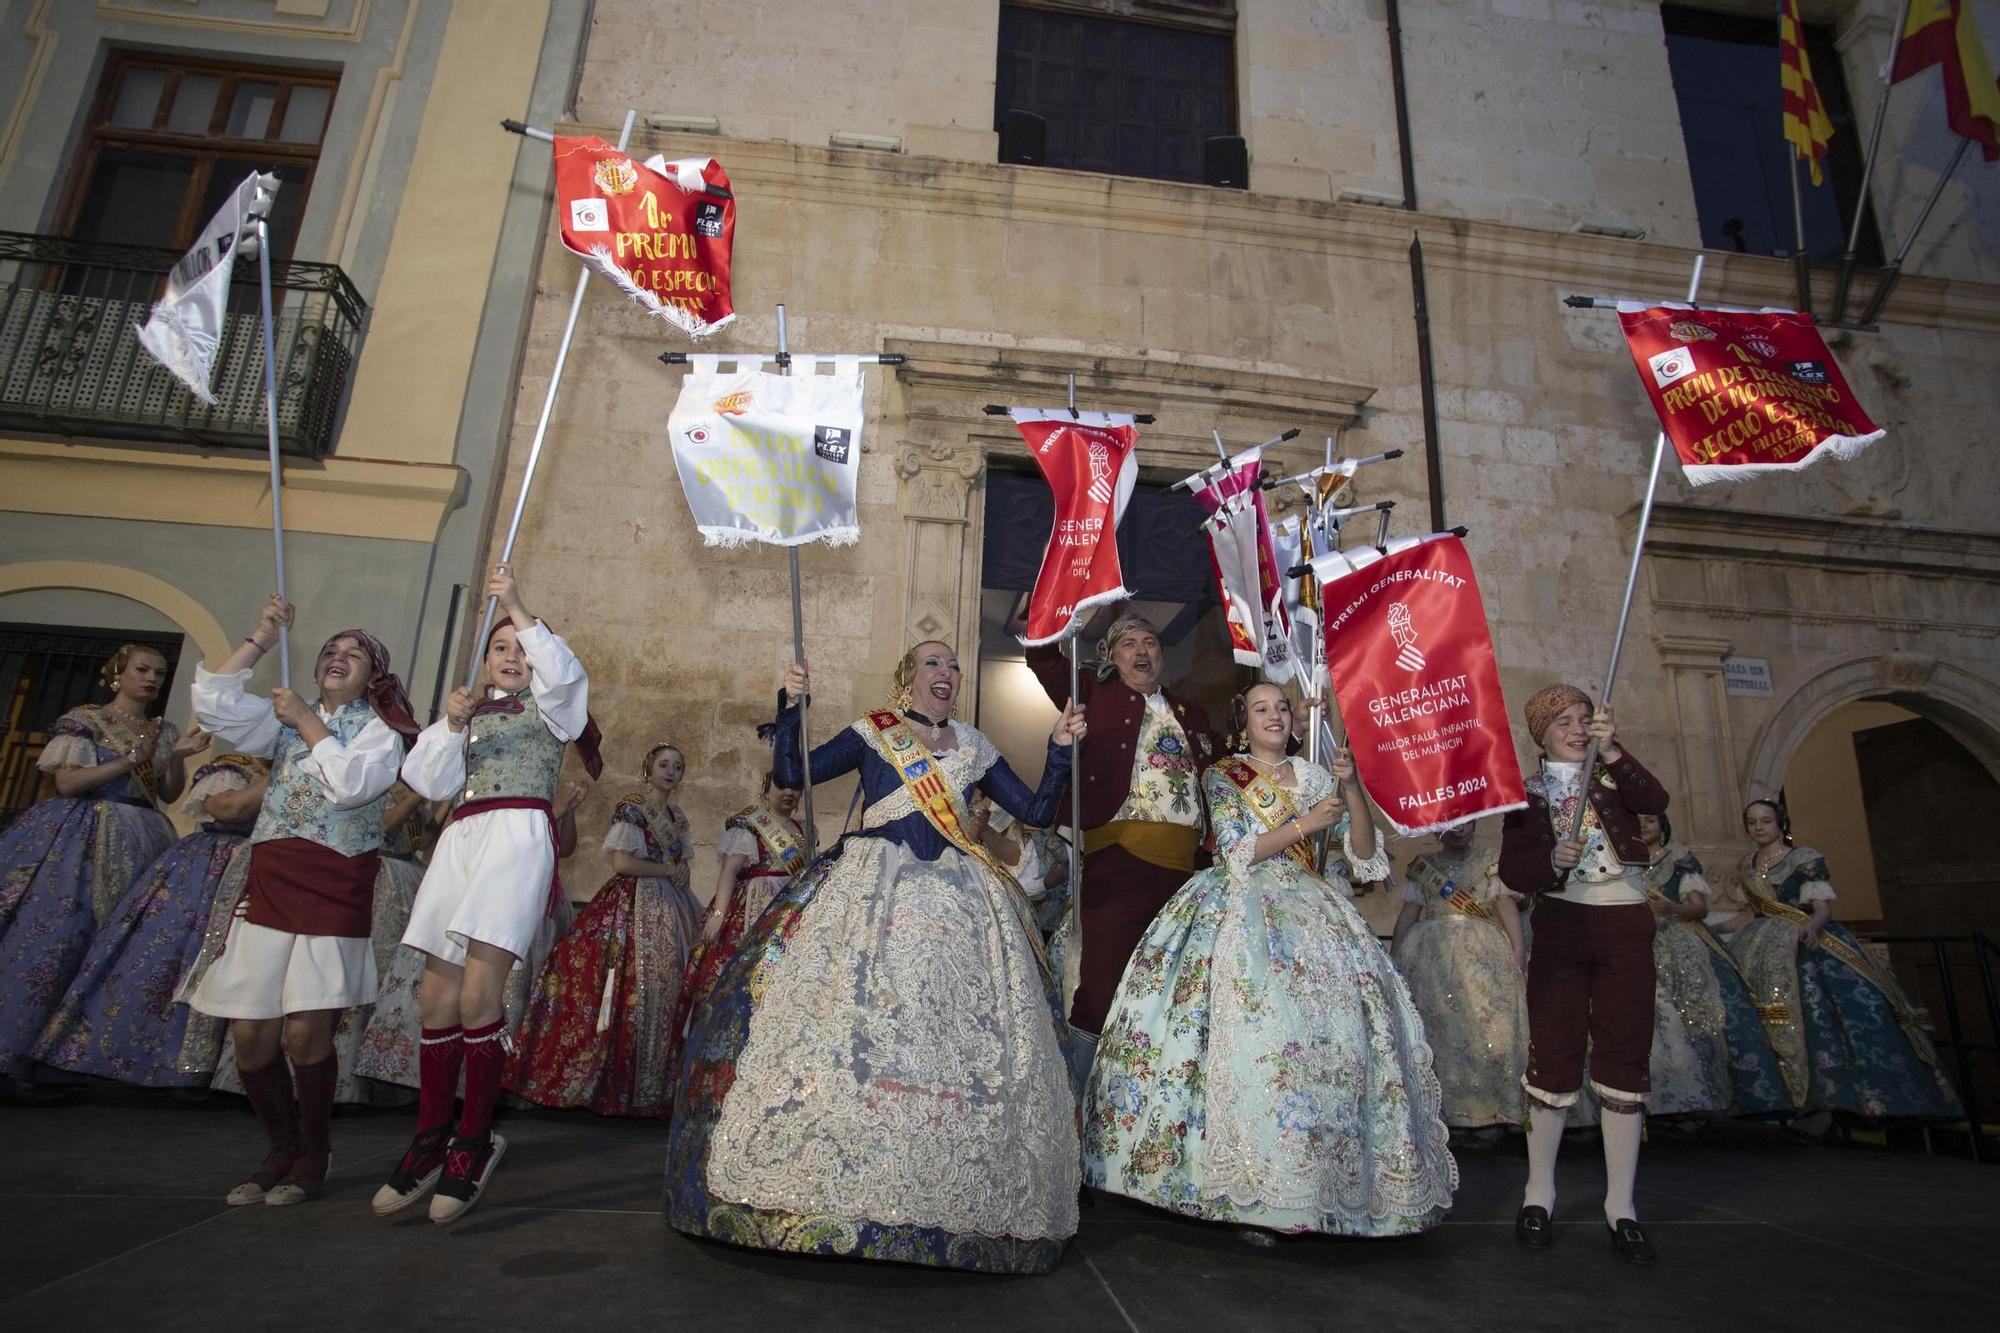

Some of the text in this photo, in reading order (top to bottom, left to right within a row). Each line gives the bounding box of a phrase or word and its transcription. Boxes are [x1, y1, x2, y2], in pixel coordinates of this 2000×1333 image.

[696, 218, 722, 229] FLEX
[616, 232, 697, 260] PREMI
[1662, 372, 1717, 415] PREMI
[1717, 366, 1748, 388] DE
[1700, 392, 1728, 425] DE
[816, 442, 847, 454] FLEX
[1040, 426, 1068, 454] PREM
[1692, 404, 1762, 465] SECCIÓ
[1060, 518, 1102, 532] GENER
[1059, 534, 1100, 546] VALEN
[1332, 592, 1368, 630] PREMI
[1370, 568, 1466, 594] GENERALITAT
[1368, 674, 1468, 713] GENERALITAT
[1372, 694, 1470, 728] VALENCIANA
[1378, 718, 1482, 752] MILLOR FALLA INFANTIL
[900, 750, 922, 764] 2024
[1402, 738, 1464, 762] DEL MUNICIPI
[1398, 778, 1488, 811] FALLES 2024
[1270, 806, 1288, 822] 2024
